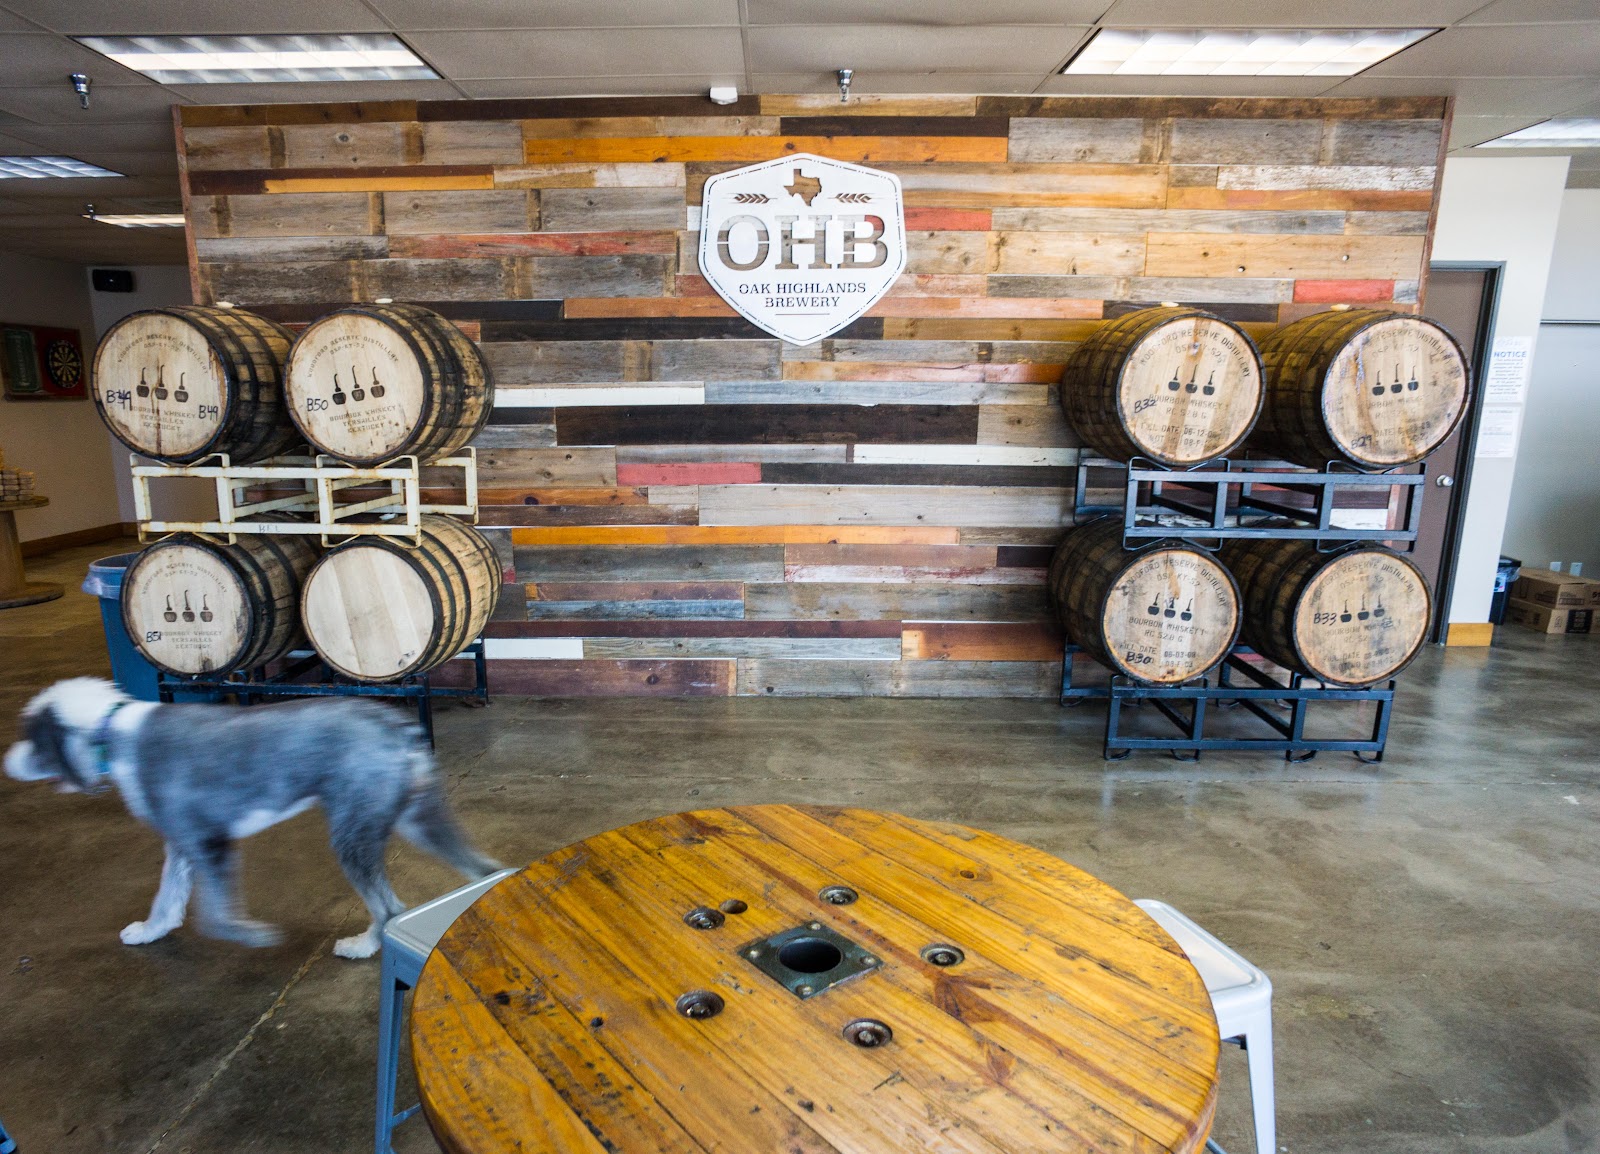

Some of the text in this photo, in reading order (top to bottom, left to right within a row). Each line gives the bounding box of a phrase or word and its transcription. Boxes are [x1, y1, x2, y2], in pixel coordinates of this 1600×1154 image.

[717, 214, 888, 271] OHB
[739, 282, 866, 294] OAK HIGHLANDS
[765, 296, 840, 308] BREWERY
[306, 398, 329, 412] B50
[1134, 398, 1157, 413] B32
[198, 404, 218, 421] B49
[1314, 612, 1337, 626] B33
